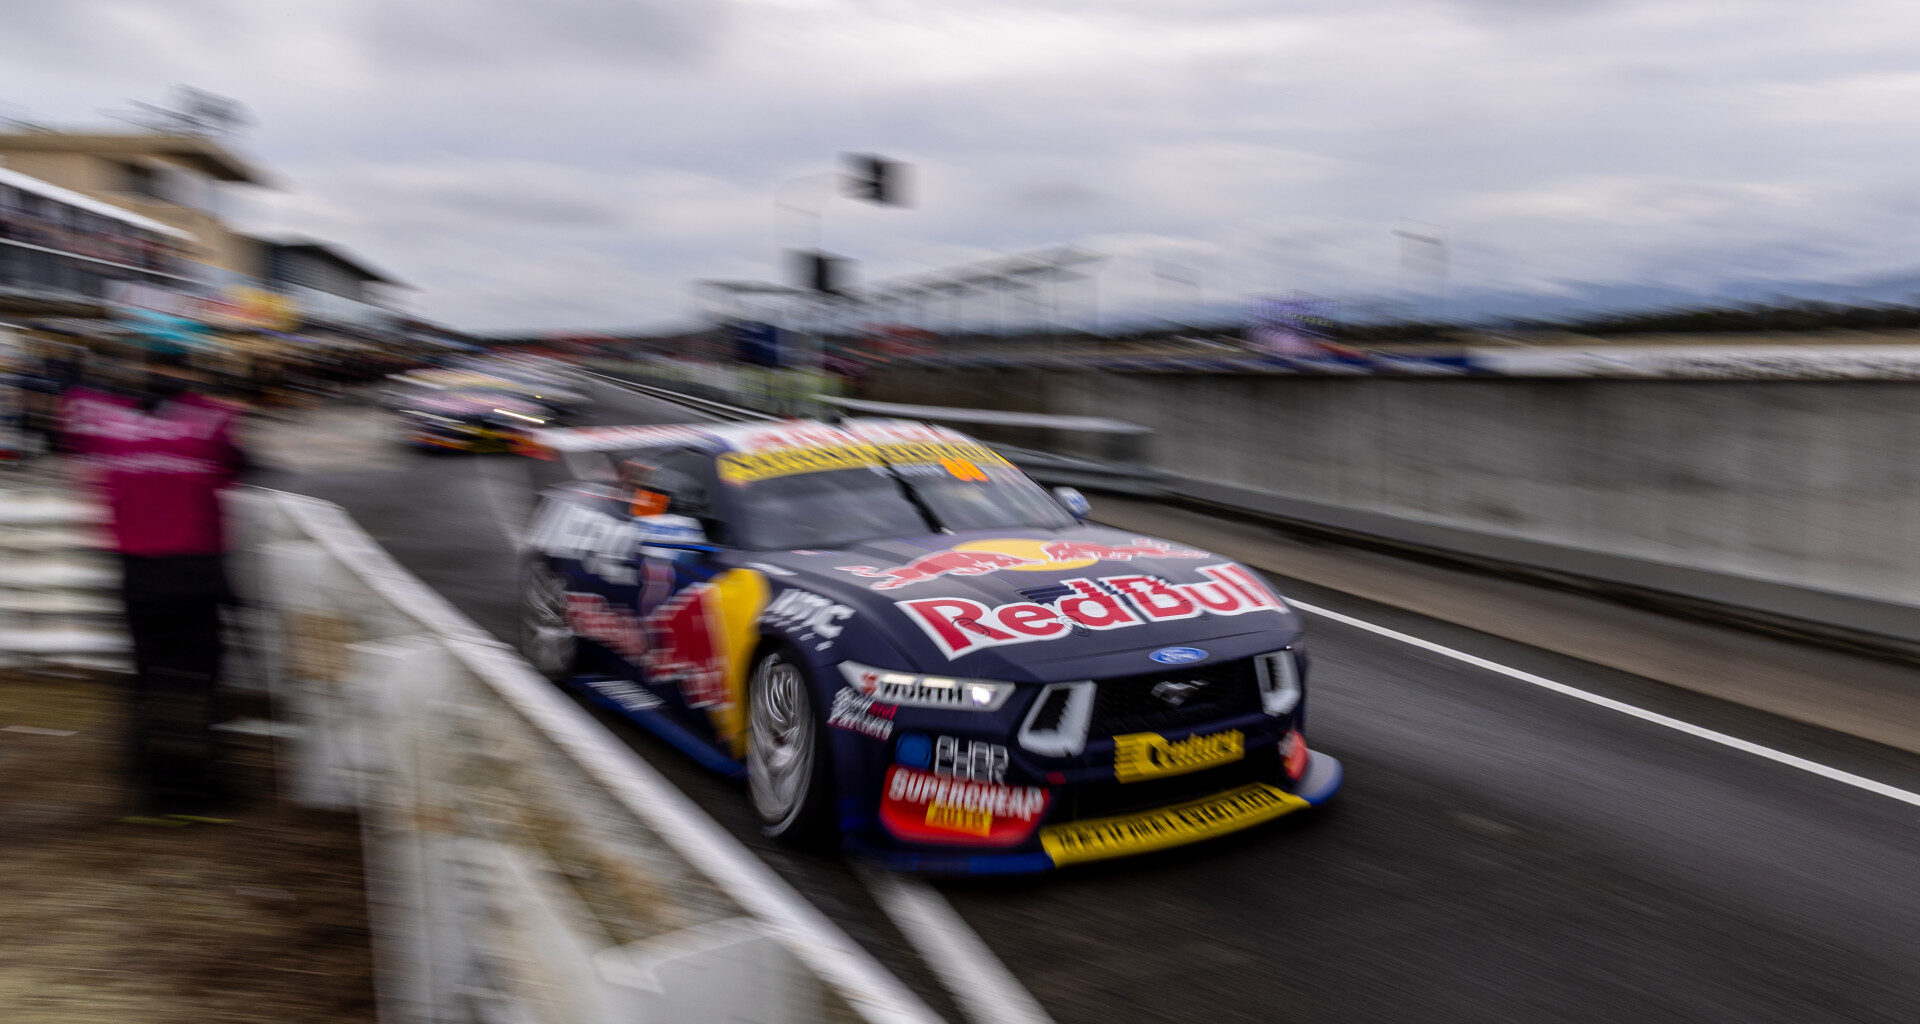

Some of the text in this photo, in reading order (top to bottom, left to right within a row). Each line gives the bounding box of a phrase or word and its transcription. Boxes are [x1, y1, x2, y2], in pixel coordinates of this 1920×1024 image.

[899, 579, 1142, 657] Red
[1102, 563, 1288, 621] Bull
[888, 768, 1044, 822] SUPERCHEAP
